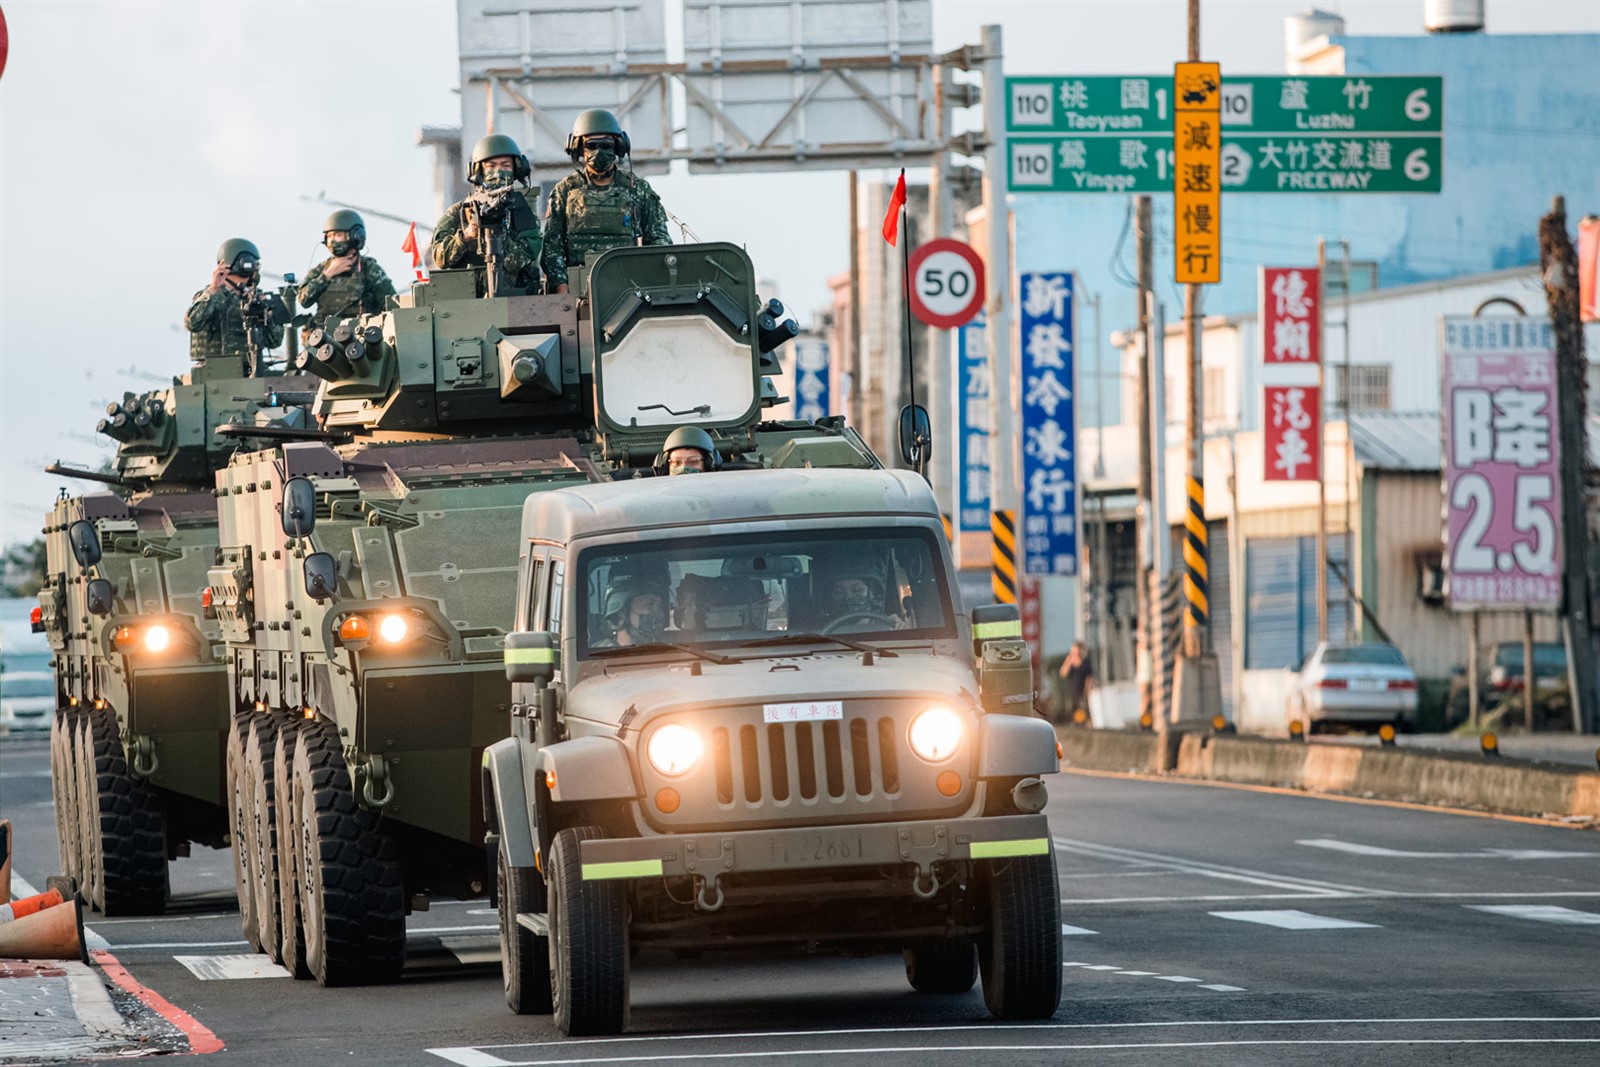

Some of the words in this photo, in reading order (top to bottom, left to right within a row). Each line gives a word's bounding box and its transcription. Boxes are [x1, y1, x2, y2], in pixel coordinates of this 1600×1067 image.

[1017, 95, 1048, 114] 110
[1059, 78, 1149, 109] 桃園
[1224, 94, 1248, 114] 10
[1279, 79, 1372, 110] 蘆竹
[1404, 87, 1431, 121] 6
[1065, 111, 1143, 132] Taoyuan
[1295, 112, 1355, 129] Luzhu
[1017, 155, 1048, 174] 110
[1058, 140, 1148, 169] 鶯歌
[1155, 149, 1174, 180] 1
[1258, 140, 1392, 170] 大竹交流道
[1403, 147, 1430, 181] 6
[1277, 171, 1372, 189] FREEWAY
[1072, 171, 1136, 192] Yingge
[1183, 121, 1213, 274] 減速慢行
[924, 269, 970, 298] 50
[1024, 275, 1074, 513] 新發冷凍行
[1272, 387, 1312, 480] 汽車
[1453, 386, 1550, 467] 降
[1453, 474, 1555, 575] 2.5
[767, 703, 840, 720] 後有車隊
